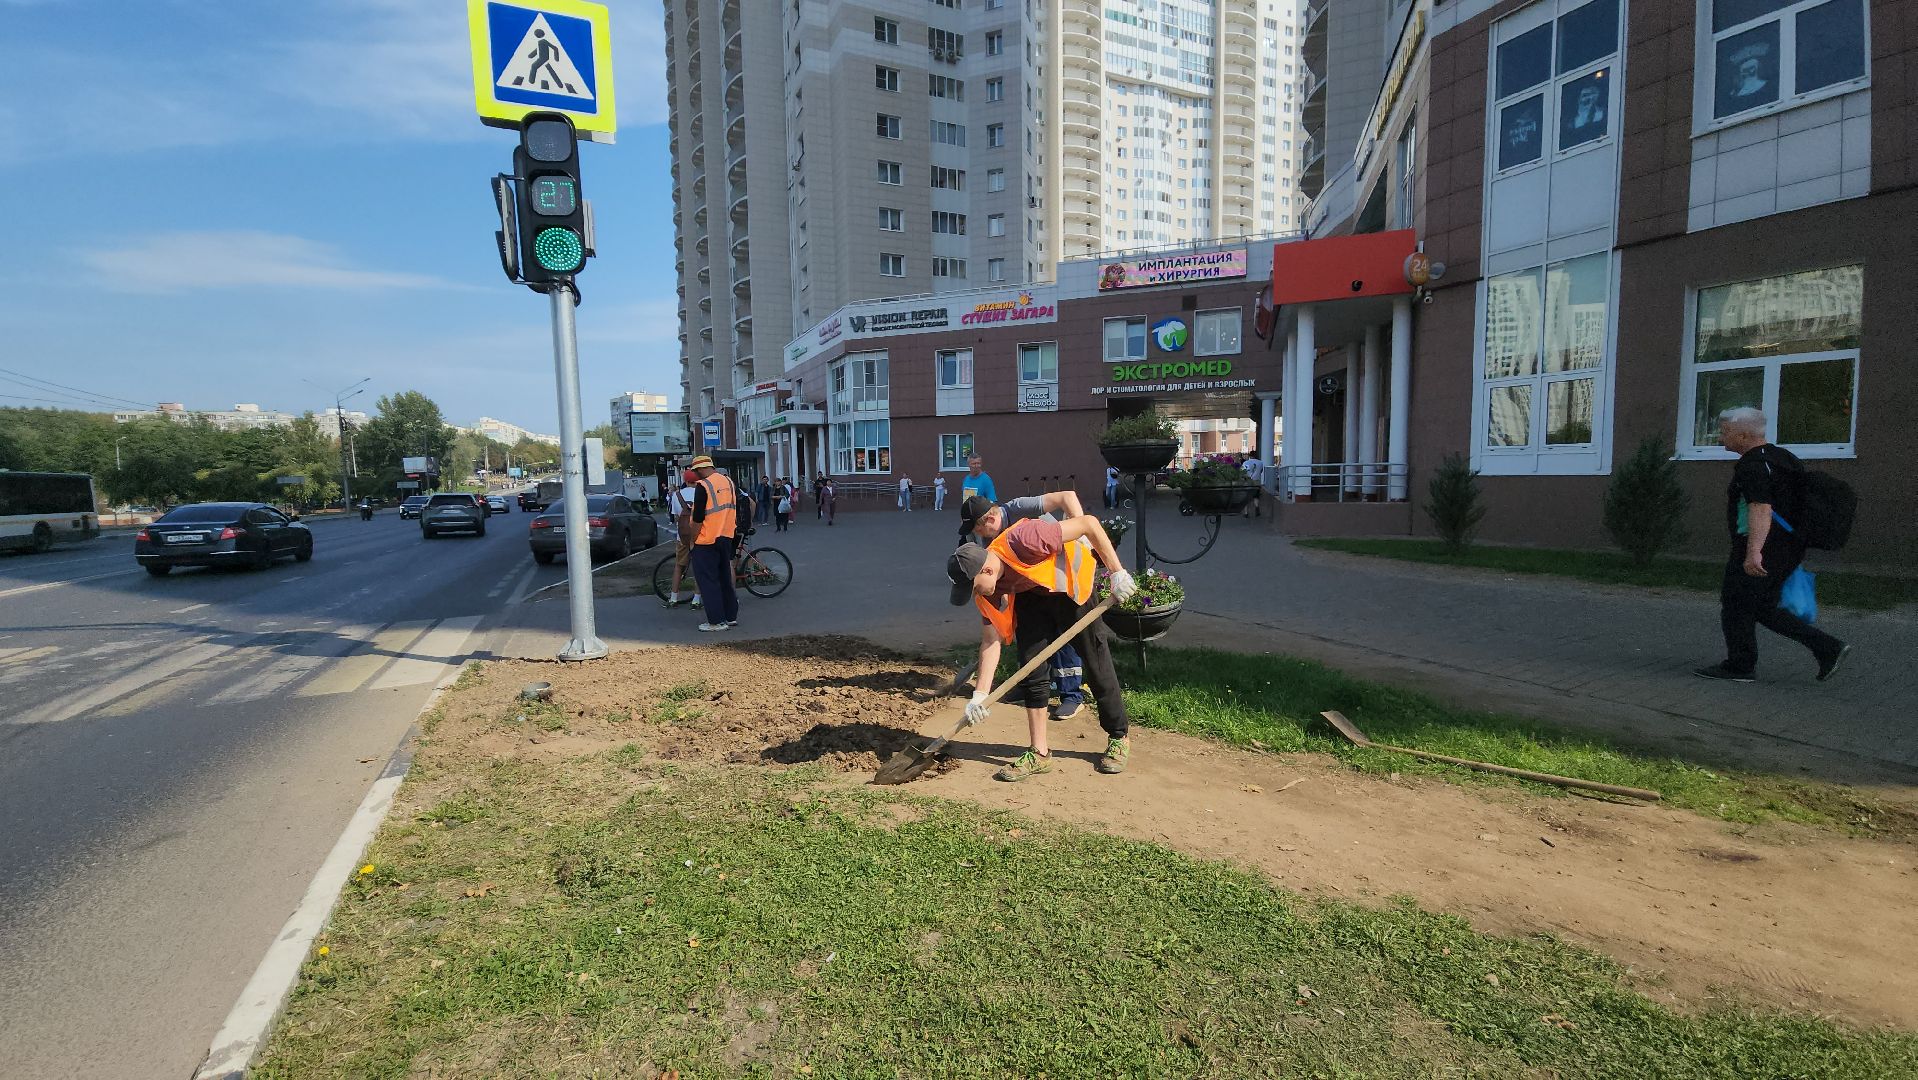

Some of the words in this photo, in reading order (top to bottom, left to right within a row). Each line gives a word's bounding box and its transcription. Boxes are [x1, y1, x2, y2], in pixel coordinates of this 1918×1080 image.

[1138, 253, 1232, 271] ИМПЛАНТАЦИЯ
[1413, 259, 1427, 271] 24
[1158, 267, 1220, 282] ХИРУРГИЯ
[974, 301, 1016, 312] ВИТАМИН
[872, 312, 907, 325] VISION
[911, 308, 948, 321] REPAIR
[961, 310, 1007, 325] СТУДИЯ
[1010, 305, 1054, 320] ЗАГАРА
[1091, 387, 1105, 395] ЛОР
[1107, 386, 1112, 394] И
[1112, 384, 1166, 394] СТОМАТОЛОГИЯ
[1167, 383, 1182, 392] ДЛЯ
[1184, 380, 1206, 391] ДЕТЕЙ
[1214, 379, 1256, 388] ВЗРОСЛЫХ
